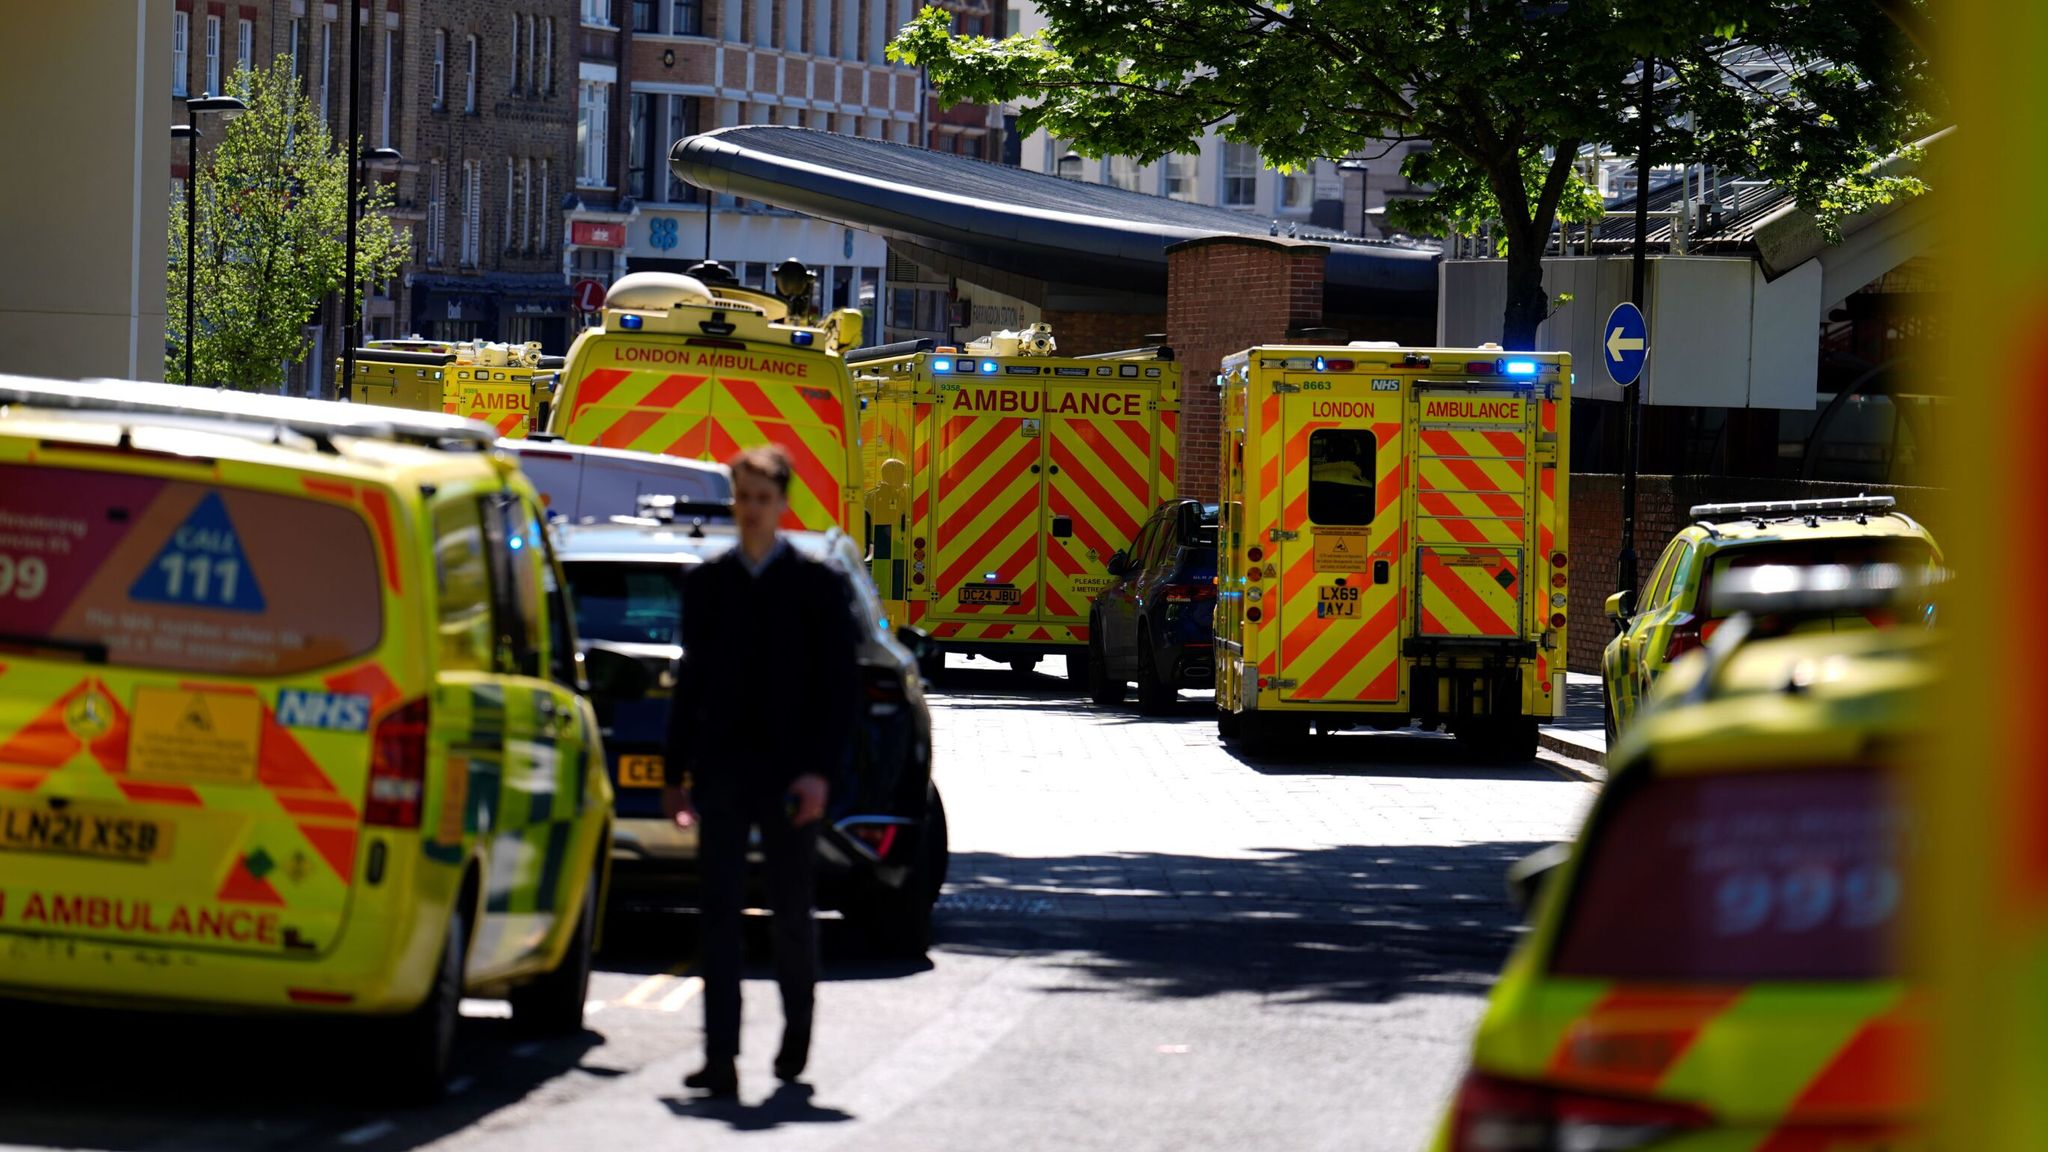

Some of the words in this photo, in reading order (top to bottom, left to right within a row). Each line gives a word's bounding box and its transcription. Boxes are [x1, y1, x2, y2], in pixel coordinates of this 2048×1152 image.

[615, 347, 690, 365] LONDON
[697, 353, 808, 377] AMBULANCE
[1303, 381, 1331, 390] 8663
[1372, 380, 1398, 390] NHS
[471, 393, 530, 410] AMBU
[953, 389, 1141, 416] AMBULANCE
[1313, 402, 1375, 418] LONDON
[1426, 402, 1519, 418] AMBULANCE
[175, 526, 235, 555] CALL
[160, 553, 239, 603] 111
[963, 589, 992, 600] DC24
[995, 590, 1016, 601] JBU
[1321, 587, 1358, 600] LX69
[1326, 602, 1353, 615] AYJ
[277, 689, 370, 732] NHS
[629, 759, 664, 780] CE
[4, 809, 82, 847] LN21
[92, 820, 159, 852] XSB
[1714, 867, 1901, 938] 999
[22, 890, 279, 946] AMBULANCE
